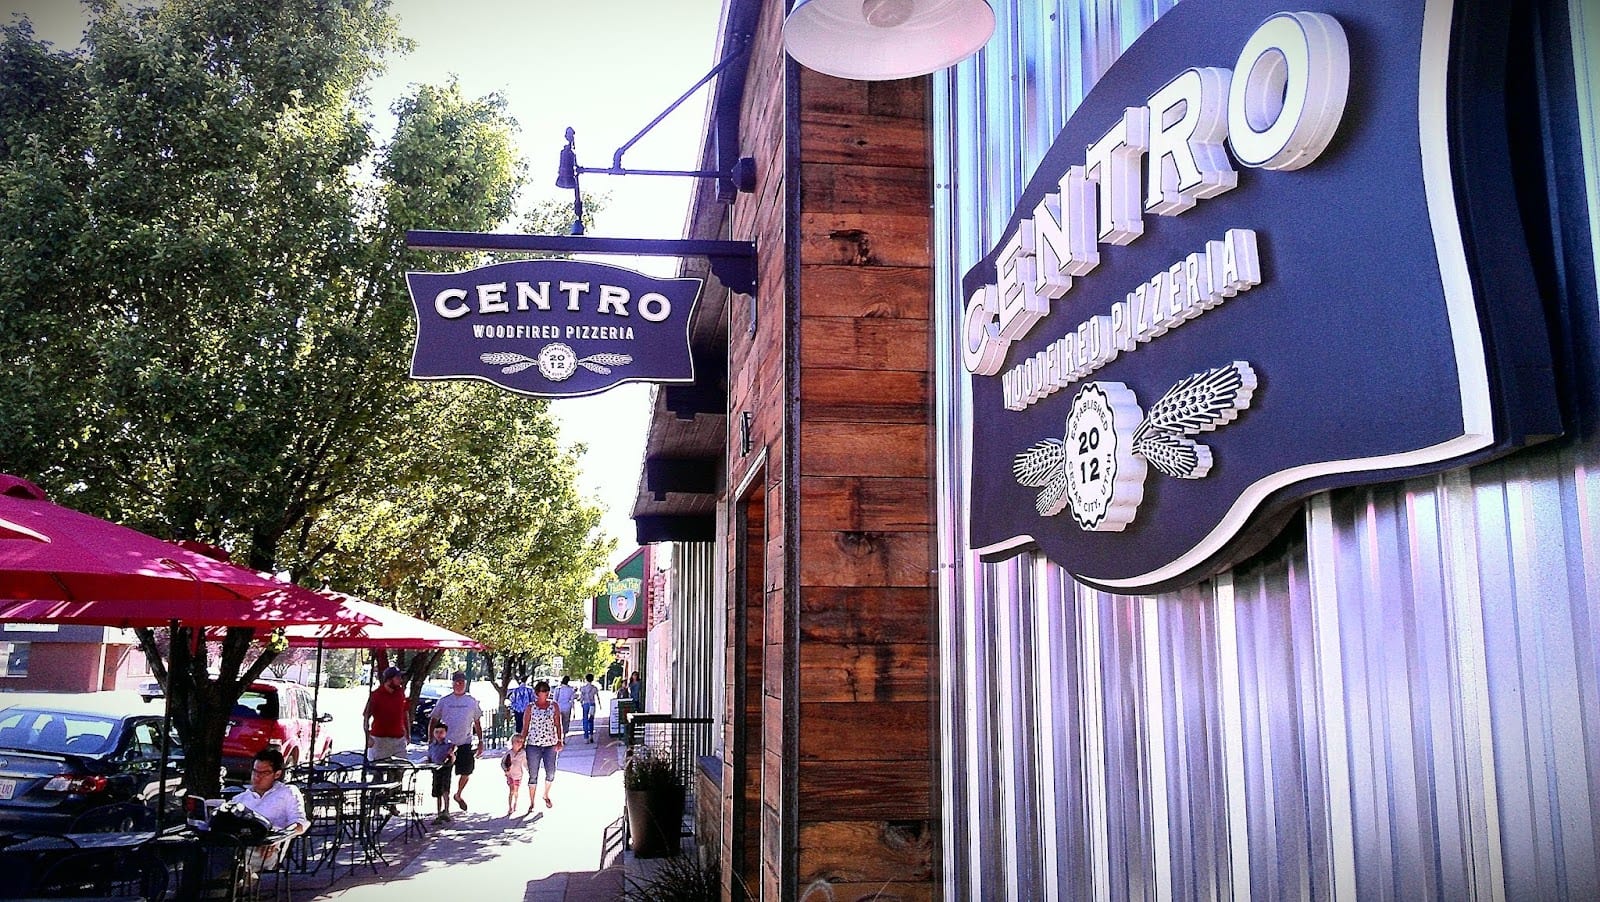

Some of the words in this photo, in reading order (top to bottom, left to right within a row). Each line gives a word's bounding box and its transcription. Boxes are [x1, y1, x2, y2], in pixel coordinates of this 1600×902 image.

[963, 10, 1350, 375] CENTRO
[434, 281, 672, 323] CENTRO
[1001, 315, 1118, 412] WOODFIRED
[1112, 228, 1262, 352] PIZZERIA
[472, 324, 560, 339] WOODFIRED
[566, 326, 635, 340] PIZZERIA
[1071, 399, 1108, 440] ESTABLISHED
[1078, 426, 1101, 455] 20
[1080, 457, 1100, 484] 12
